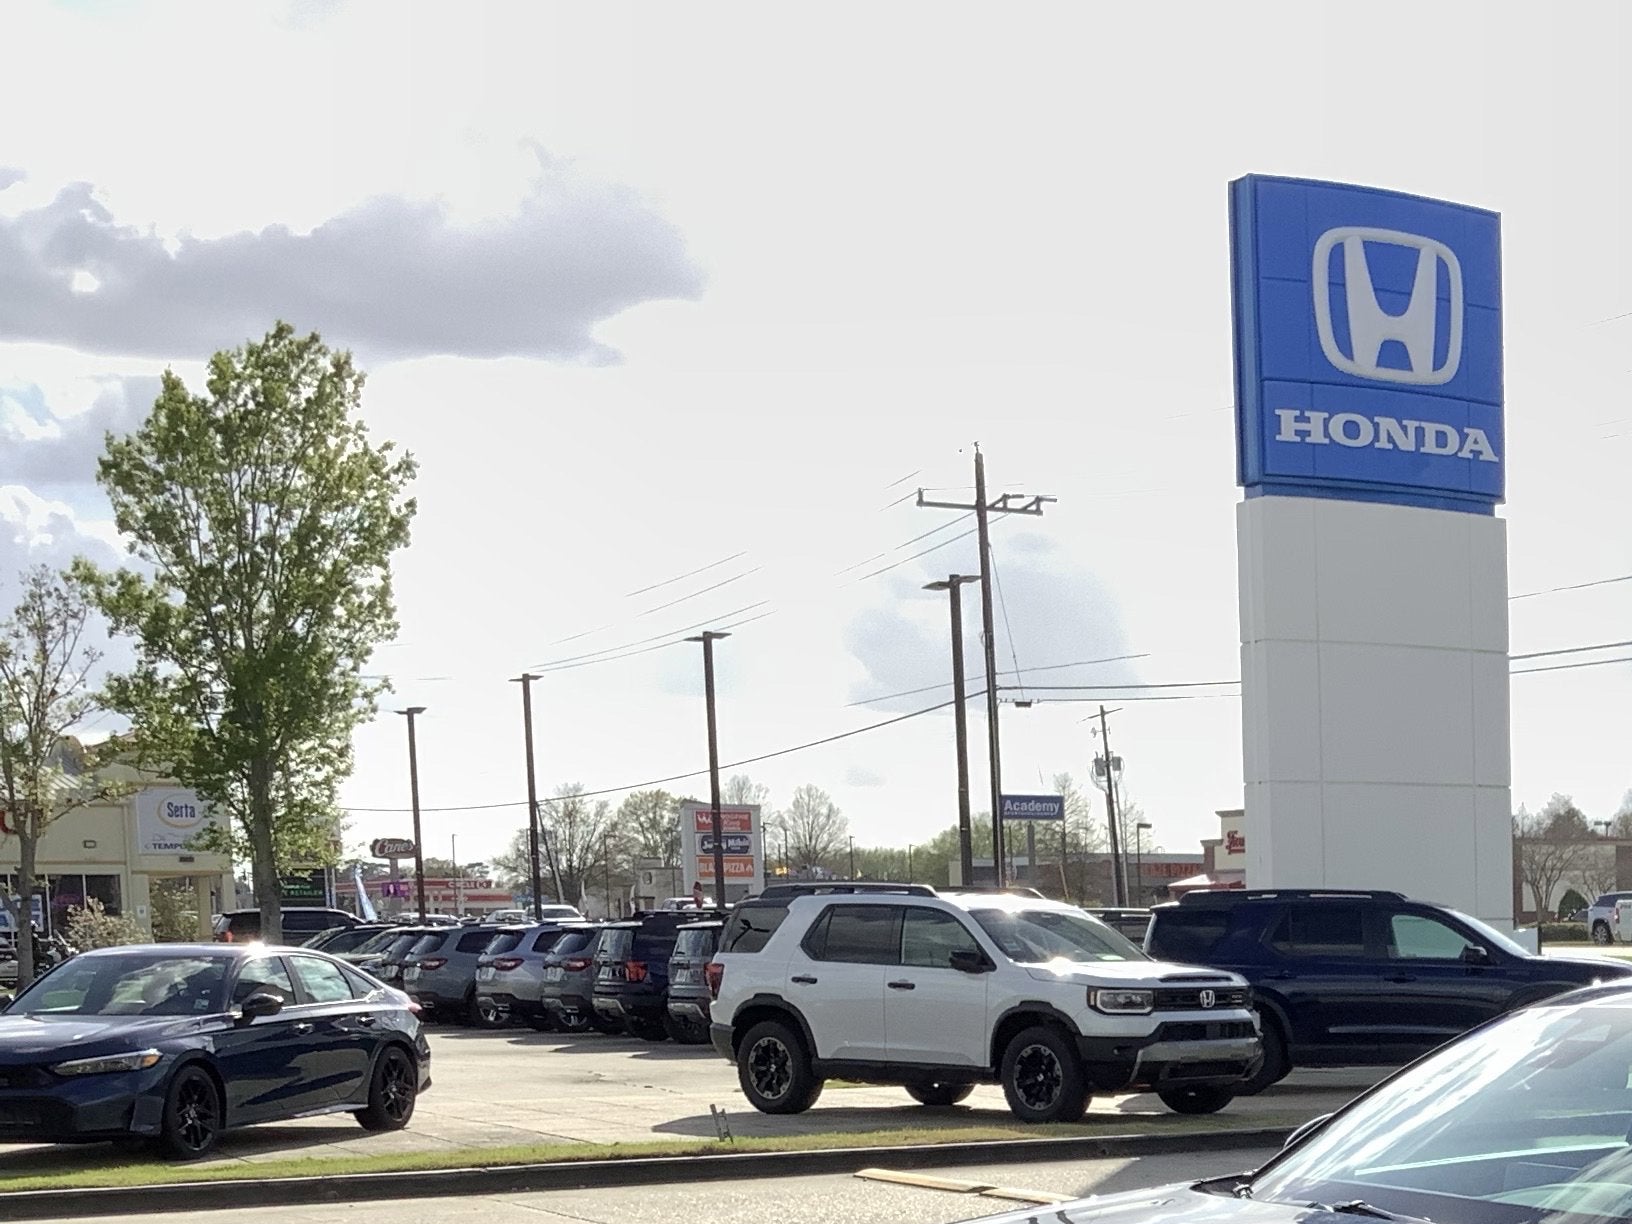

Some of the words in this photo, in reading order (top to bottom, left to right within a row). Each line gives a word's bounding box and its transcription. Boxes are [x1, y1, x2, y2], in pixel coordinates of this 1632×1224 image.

[1274, 408, 1499, 463] HONDA
[166, 801, 196, 818] Serta
[1003, 799, 1060, 814] Academy
